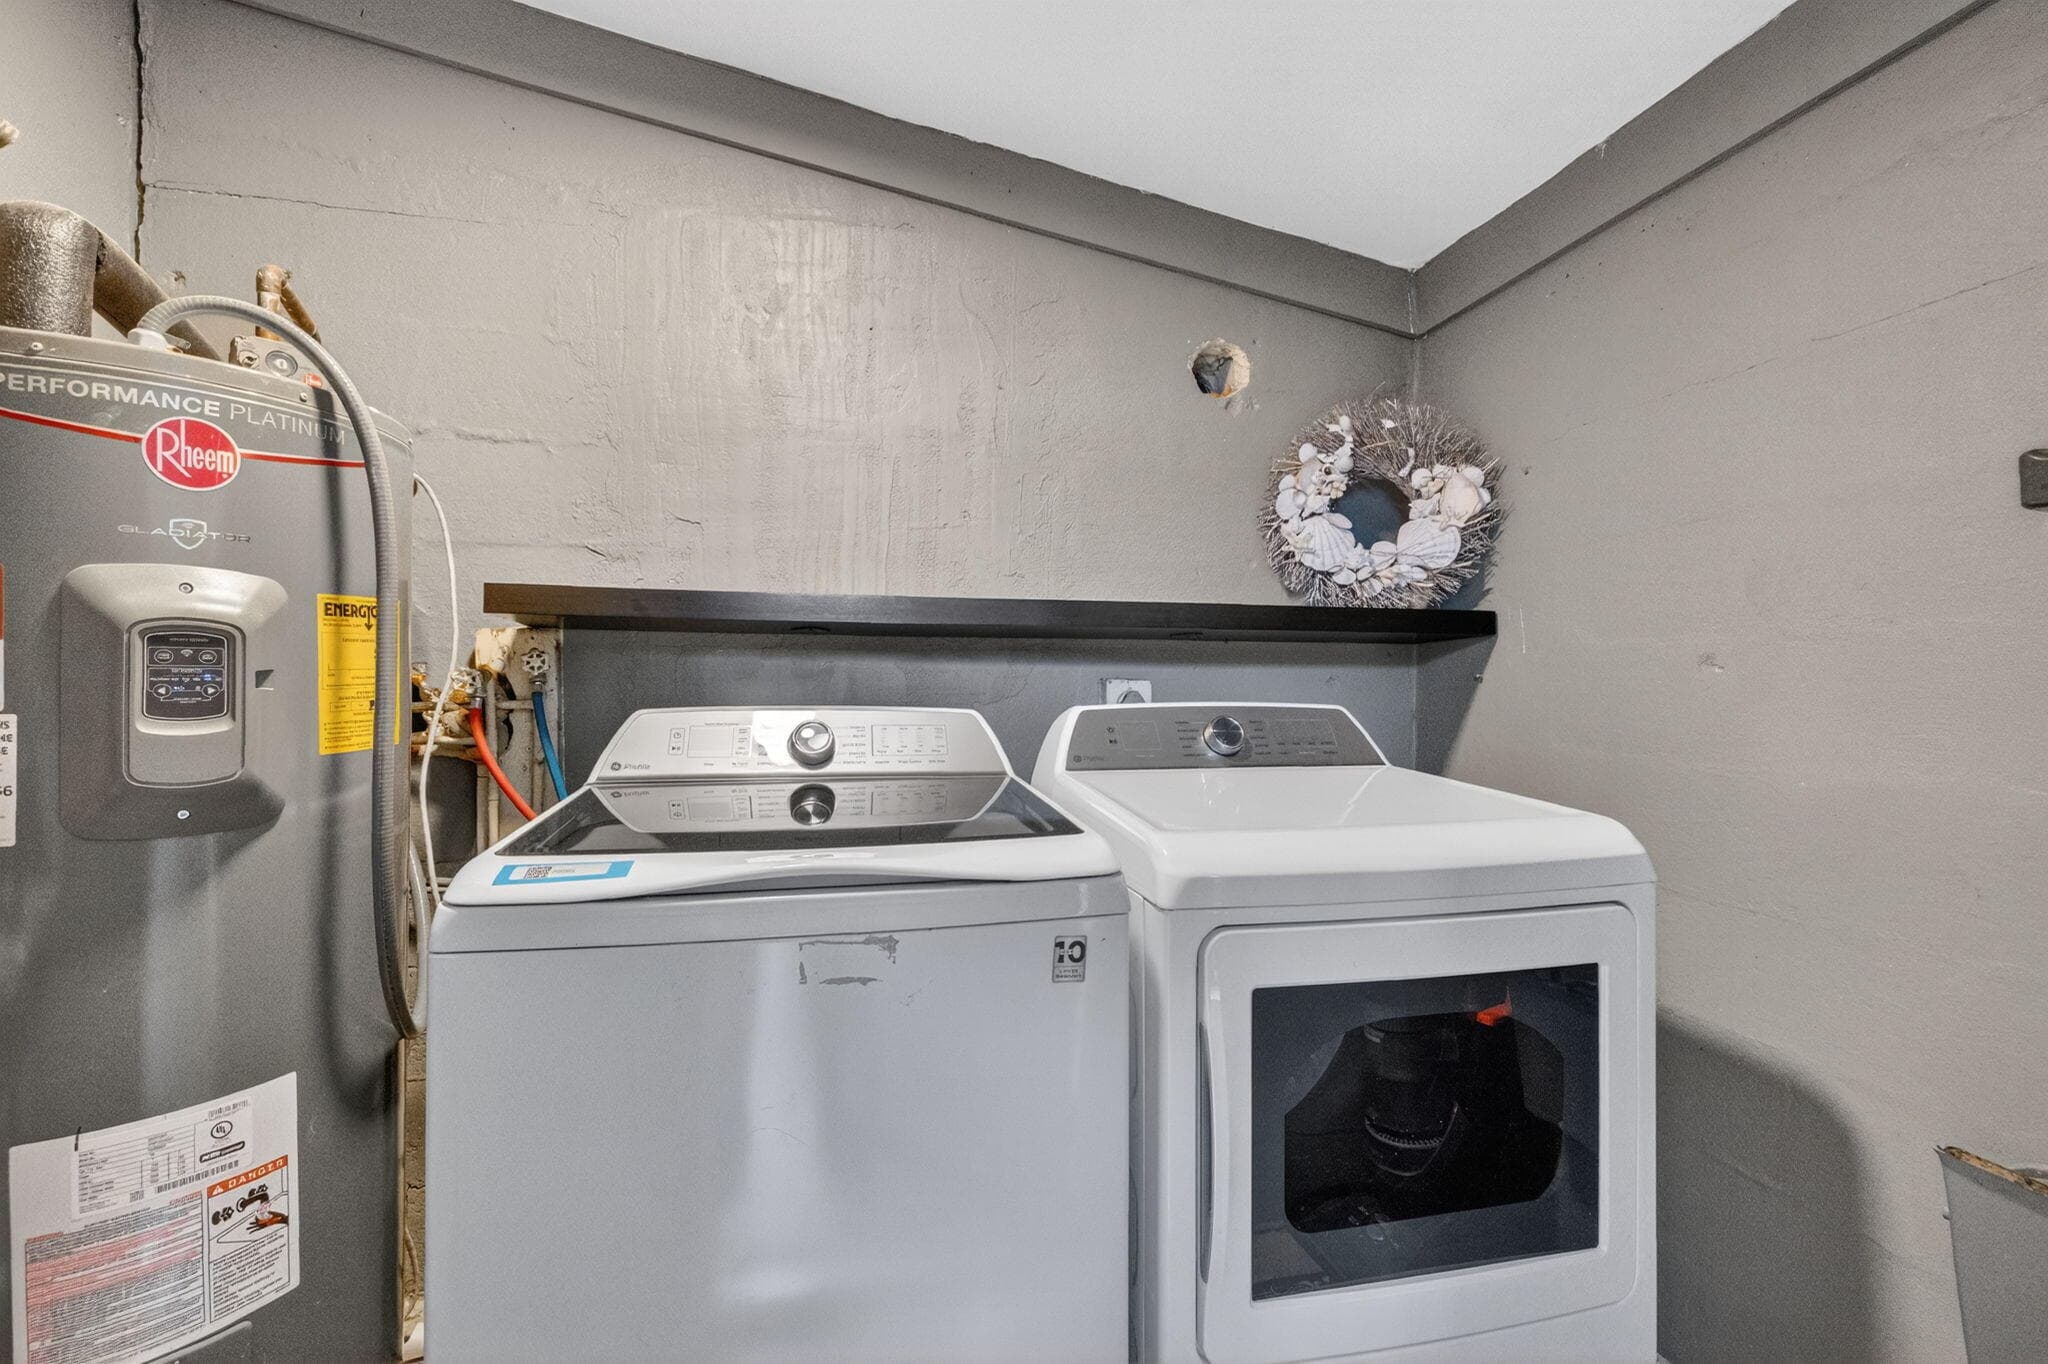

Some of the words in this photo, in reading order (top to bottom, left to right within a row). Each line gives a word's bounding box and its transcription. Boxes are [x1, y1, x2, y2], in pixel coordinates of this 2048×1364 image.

[229, 404, 346, 447] PLATINUM
[156, 417, 235, 479] Rheem
[117, 524, 251, 544] GLADIATOR
[1054, 940, 1087, 964] 10
